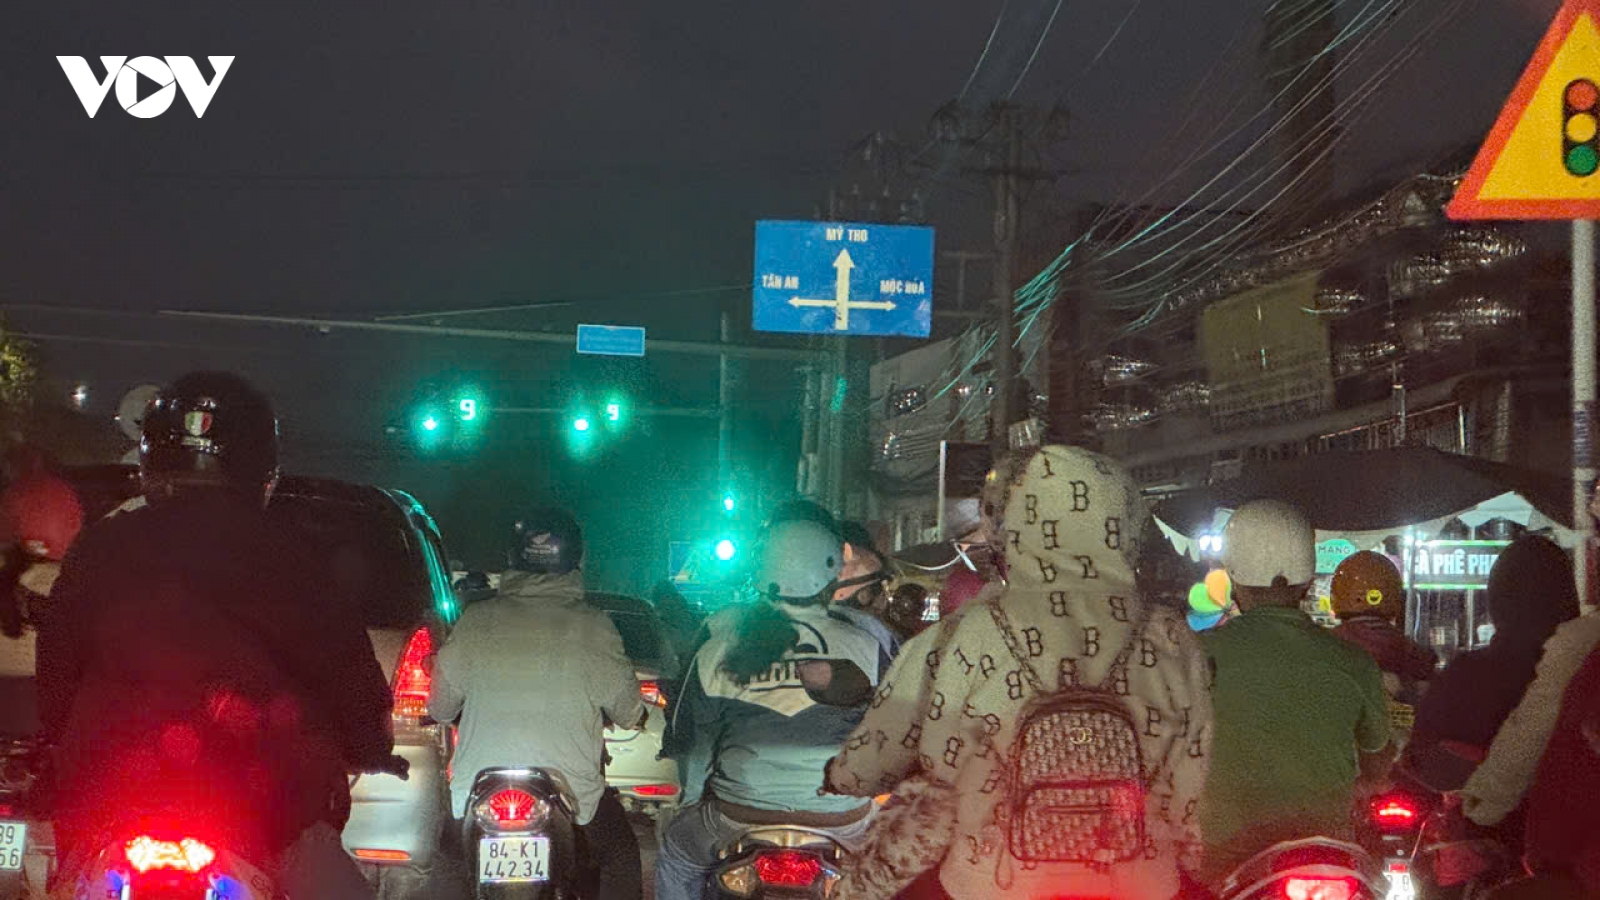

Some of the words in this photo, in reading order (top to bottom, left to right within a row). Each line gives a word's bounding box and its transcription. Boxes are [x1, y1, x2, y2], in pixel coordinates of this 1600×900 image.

[459, 399, 476, 420] 9
[606, 404, 620, 420] 9
[1433, 548, 1466, 575] PHÊ
[489, 841, 538, 859] 84-K1
[484, 860, 544, 877] 442.34
